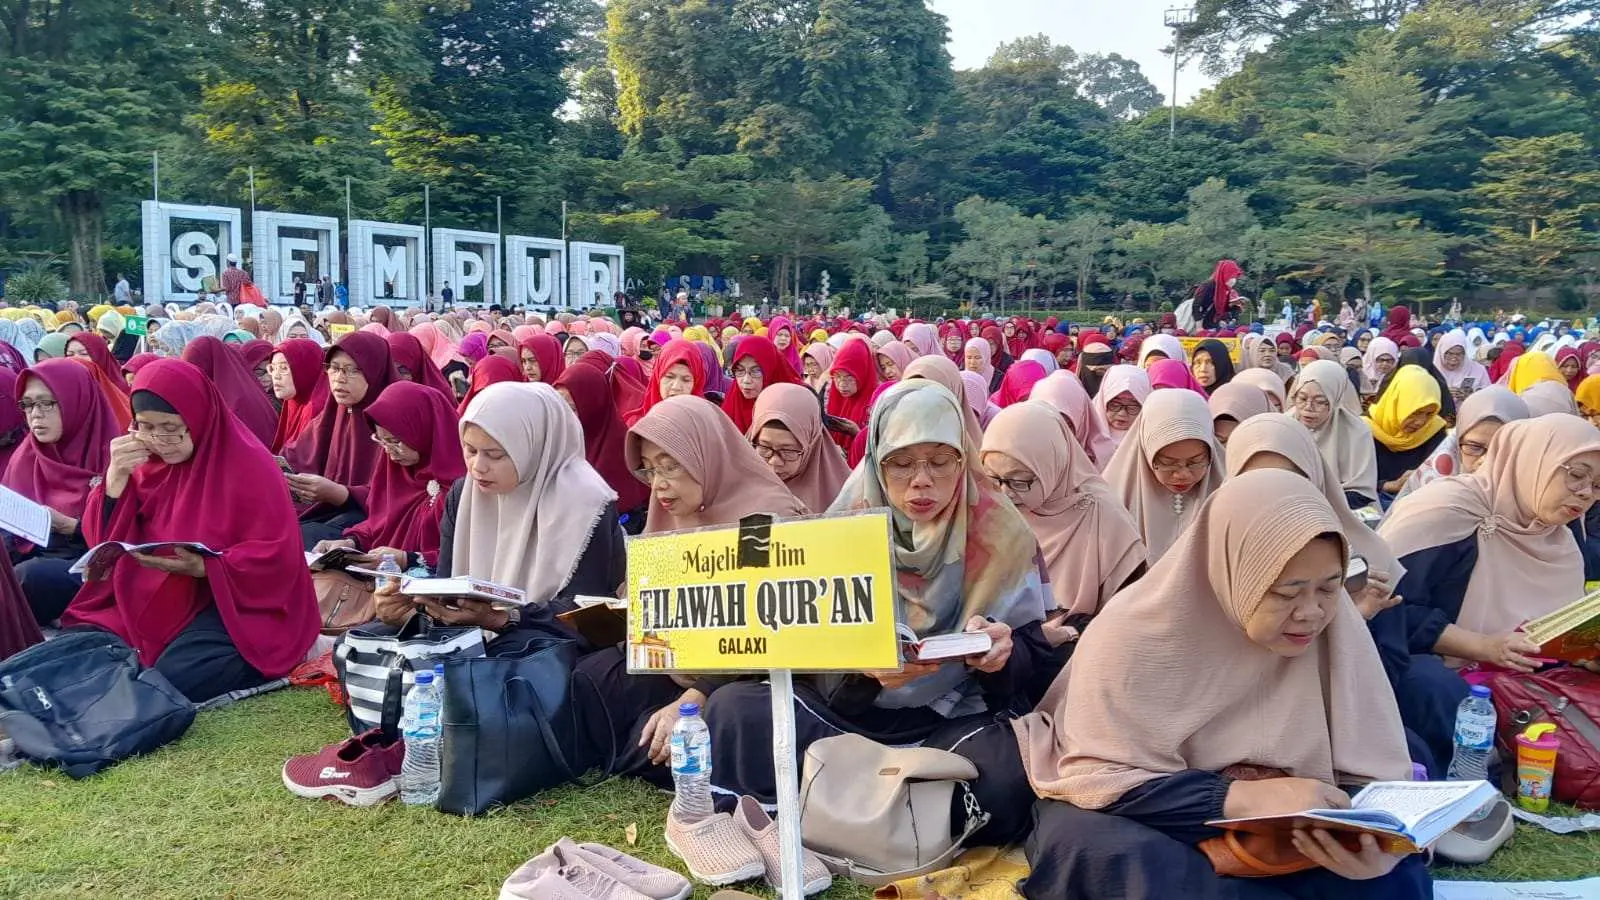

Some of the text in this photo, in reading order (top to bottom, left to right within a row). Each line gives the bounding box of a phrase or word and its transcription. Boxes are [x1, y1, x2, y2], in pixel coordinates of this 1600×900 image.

[172, 231, 610, 303] SEMPUR
[639, 576, 874, 631] TILAWAH QUR'AN
[718, 637, 767, 655] GALAXI
